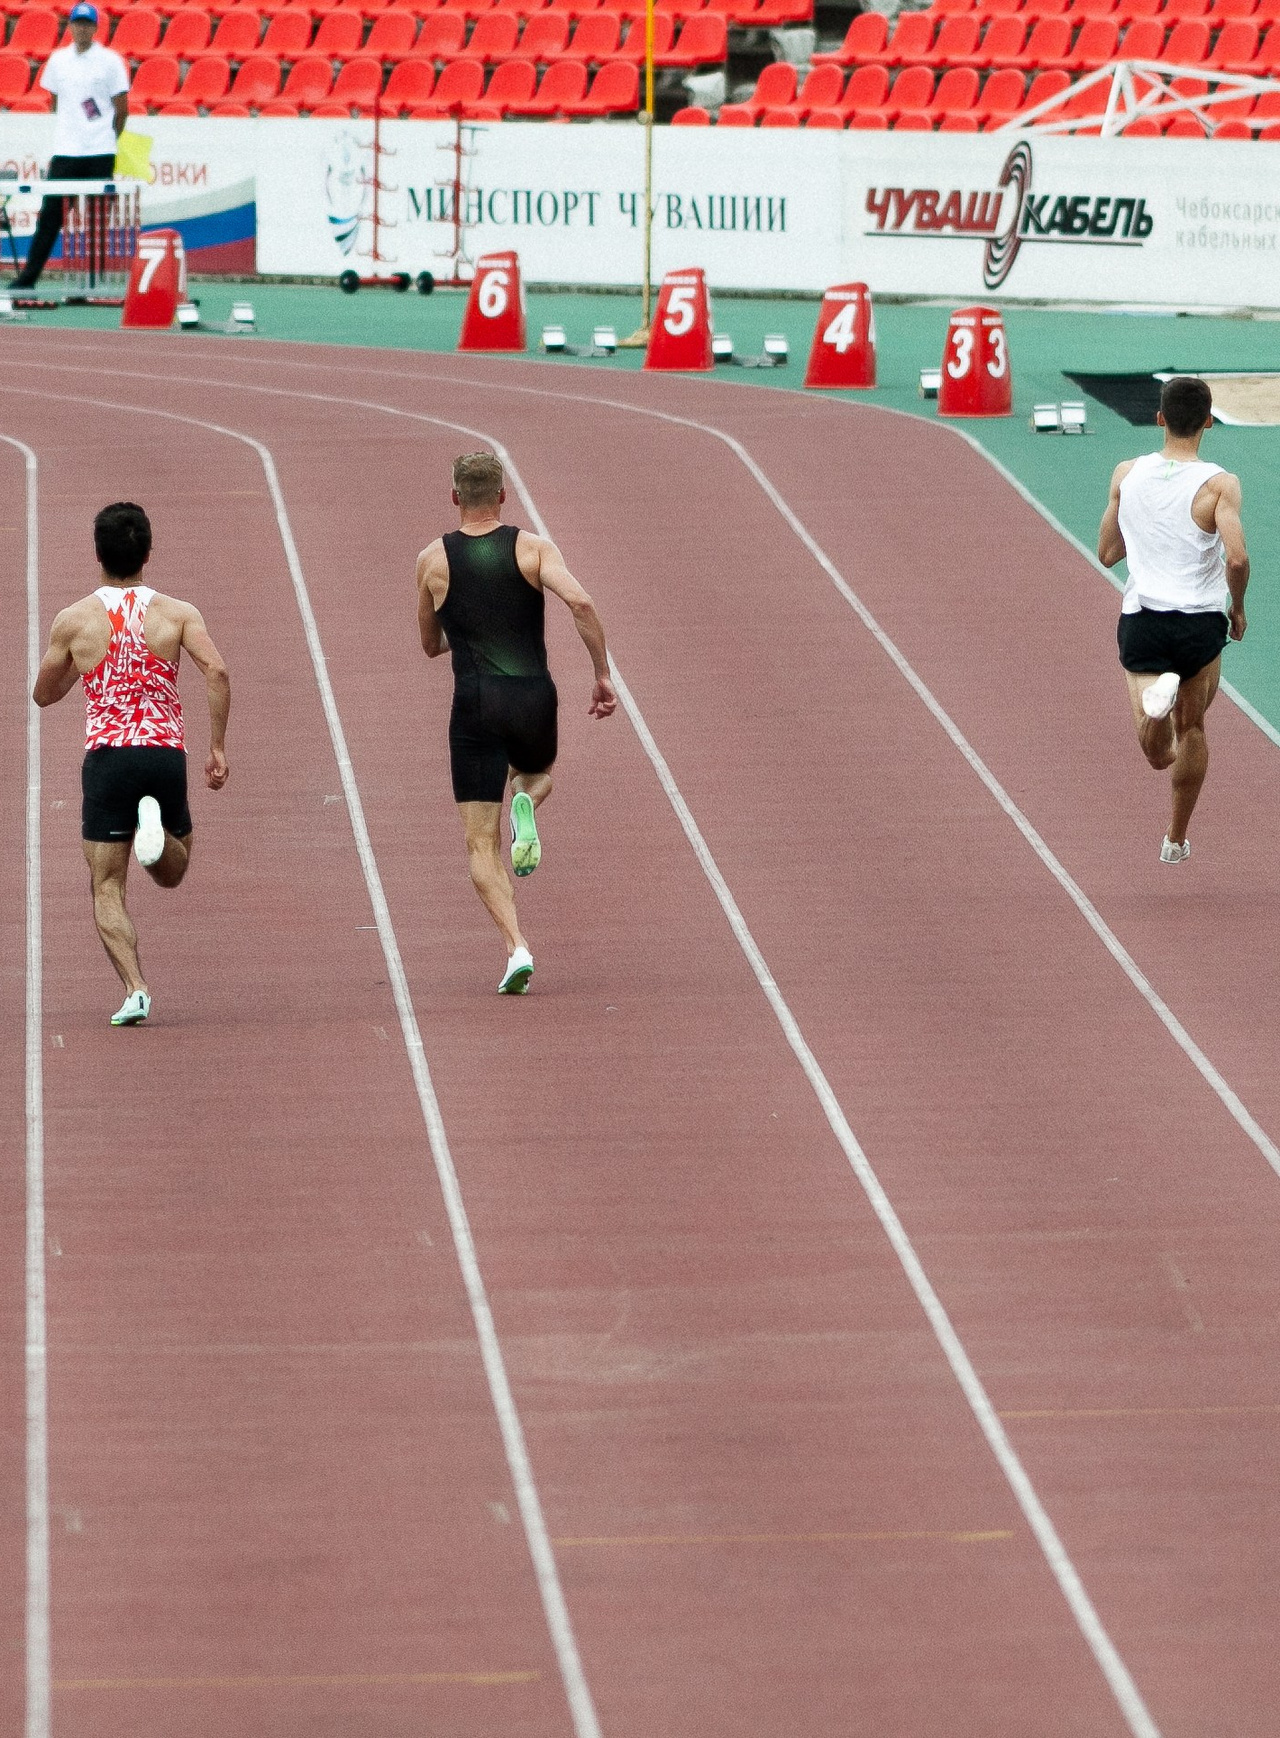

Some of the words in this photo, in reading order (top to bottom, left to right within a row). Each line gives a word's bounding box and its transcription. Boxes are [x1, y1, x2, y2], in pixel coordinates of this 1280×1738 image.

[138, 248, 166, 292] 7
[479, 270, 509, 317] 6
[663, 287, 696, 335] 5
[822, 303, 857, 353] 4
[947, 328, 973, 379] 3
[986, 328, 1006, 379] 3
